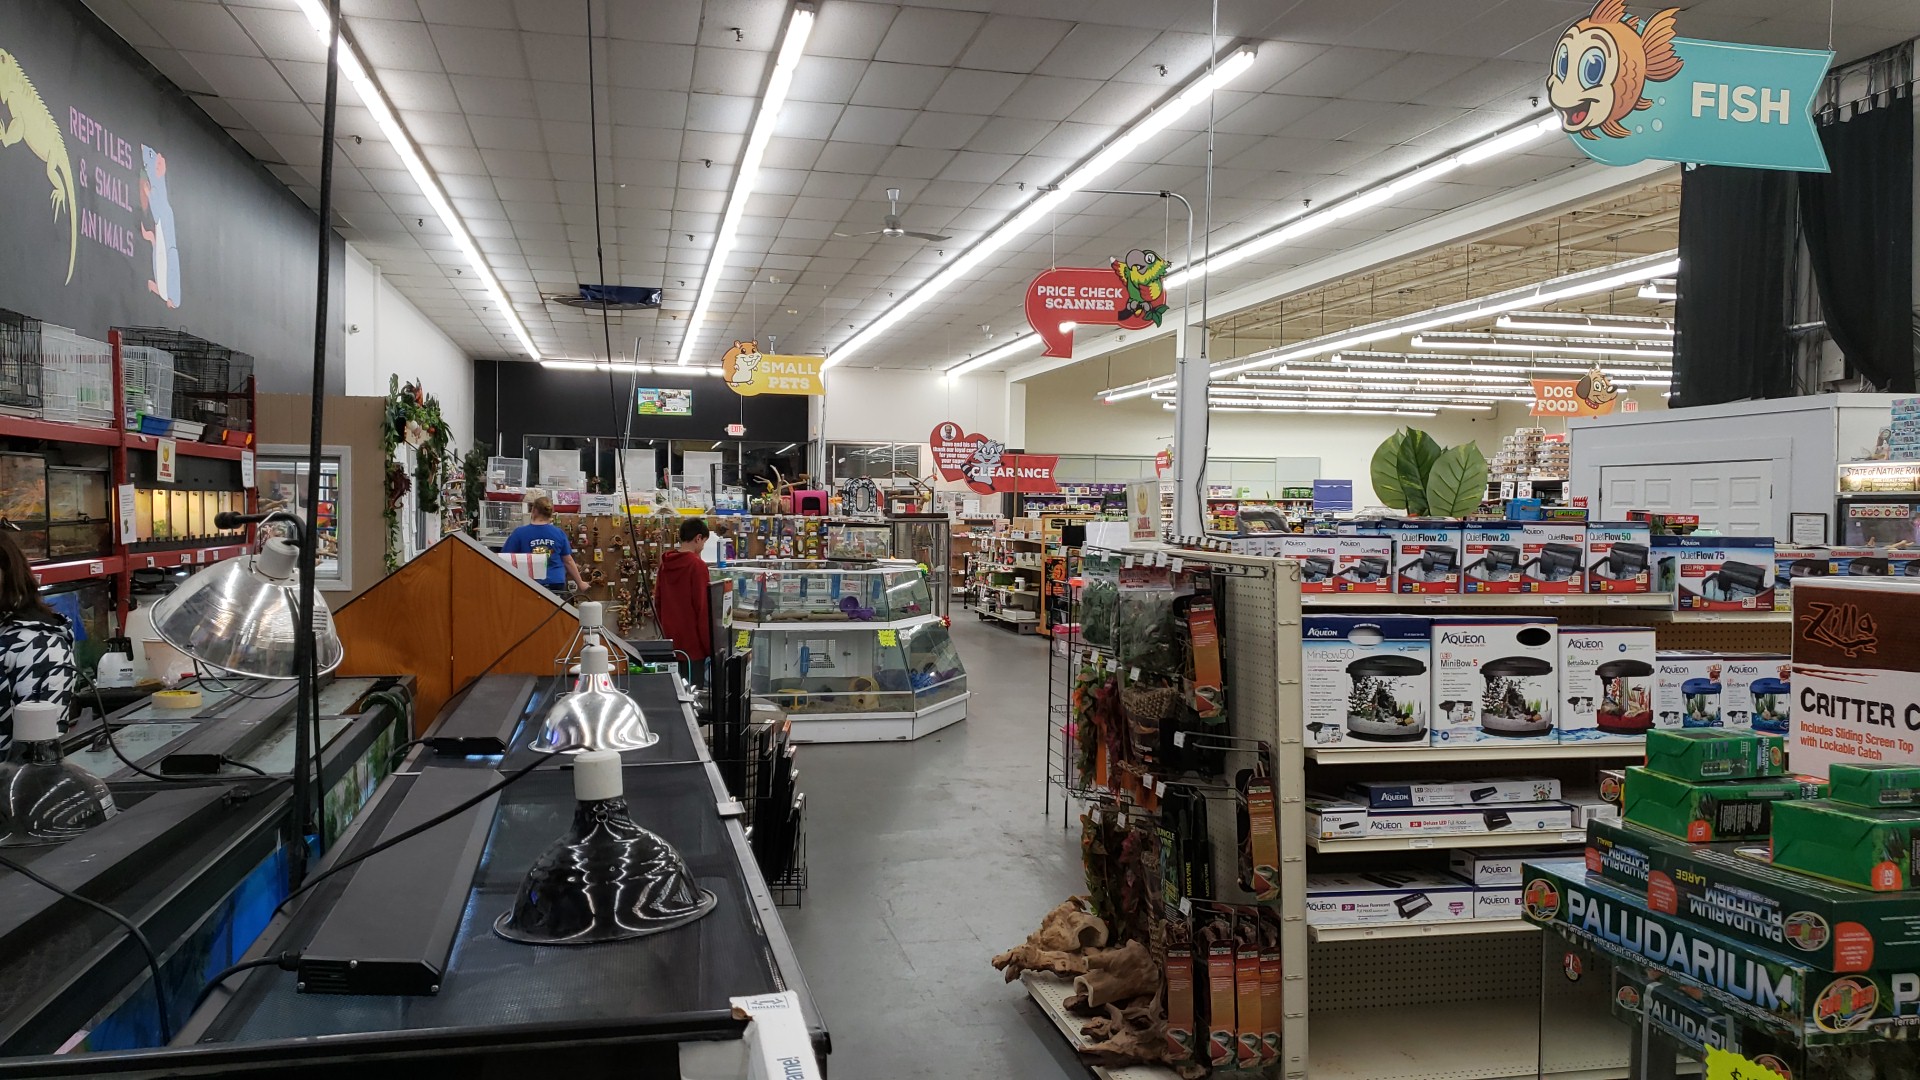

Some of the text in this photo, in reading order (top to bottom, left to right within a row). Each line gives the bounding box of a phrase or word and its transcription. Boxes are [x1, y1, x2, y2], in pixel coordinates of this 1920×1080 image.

[1691, 81, 1790, 125] FISH
[69, 105, 133, 170] REPTILES
[79, 158, 133, 213] & SMALL
[81, 208, 134, 257] ANIMALS
[1037, 285, 1123, 298] PRICE CHECK
[1045, 298, 1115, 310] SCANNER
[761, 362, 816, 375] SMALL
[768, 377, 809, 390] PETS
[1543, 386, 1573, 398] DOG
[1537, 399, 1578, 413] FOOD
[1625, 402, 1636, 411] EXIT
[731, 425, 742, 433] EXIT
[971, 466, 1050, 479] CLEARANCE
[1847, 467, 1867, 476] STATE
[1875, 467, 1905, 475] NATURE
[530, 539, 555, 547] STAFF
[1401, 533, 1447, 542] QuietFlow 20
[1466, 533, 1510, 542] QuietFlow 20
[1589, 532, 1631, 541] QuietFlow 50
[1680, 551, 1725, 560] QuietFlow 75
[1803, 602, 1875, 645] Zilla
[1440, 659, 1478, 667] MiniBow 5
[1800, 687, 1895, 729] CRITTER
[1800, 721, 1914, 754] Includes Sliding Screen Top
[1800, 735, 1882, 760] with Lockable Catch
[1596, 836, 1613, 849] SMALL
[1608, 848, 1650, 872] PLATFORM
[1600, 854, 1650, 882] PALUDARIUM
[1675, 868, 1706, 888] LARGE
[1884, 869, 1894, 886] 20
[1705, 887, 1783, 927] PLATFORM
[1690, 898, 1783, 943] PALUDARIUM
[1567, 925, 1592, 940] Terrarium
[1593, 935, 1605, 945] with
[1611, 943, 1625, 955] built
[1632, 953, 1648, 966] nano
[1567, 889, 1793, 1010] PALUDARIUM
[1891, 973, 1920, 1016] P
